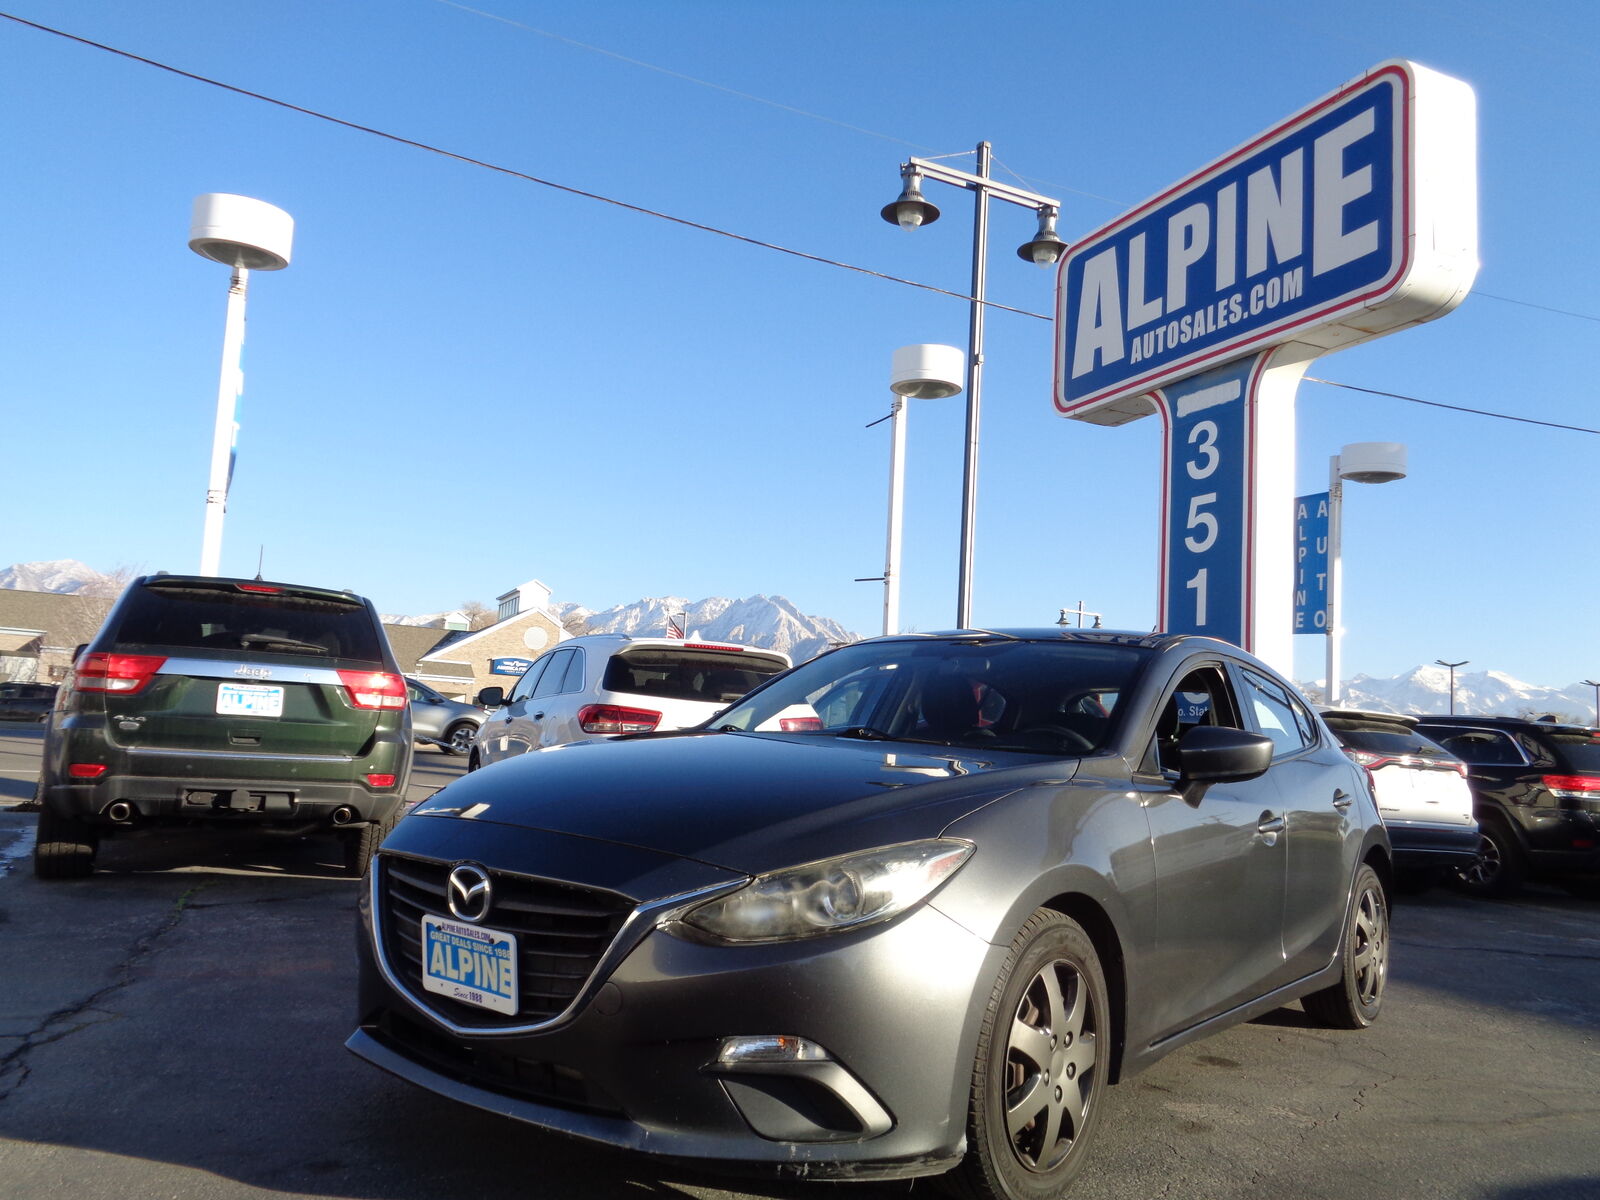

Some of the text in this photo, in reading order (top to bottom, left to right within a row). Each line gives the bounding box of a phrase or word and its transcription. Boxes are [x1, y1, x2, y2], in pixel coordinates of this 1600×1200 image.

[1071, 106, 1379, 380] ALPINE
[1130, 266, 1303, 365] AUTOSALES.COM
[1294, 503, 1308, 628] ALPINE
[1313, 500, 1328, 628] AUTO
[430, 941, 512, 995] ALPINE
[431, 931, 450, 944] GREAT
[451, 936, 472, 949] DEALS
[472, 941, 494, 955] SINCE
